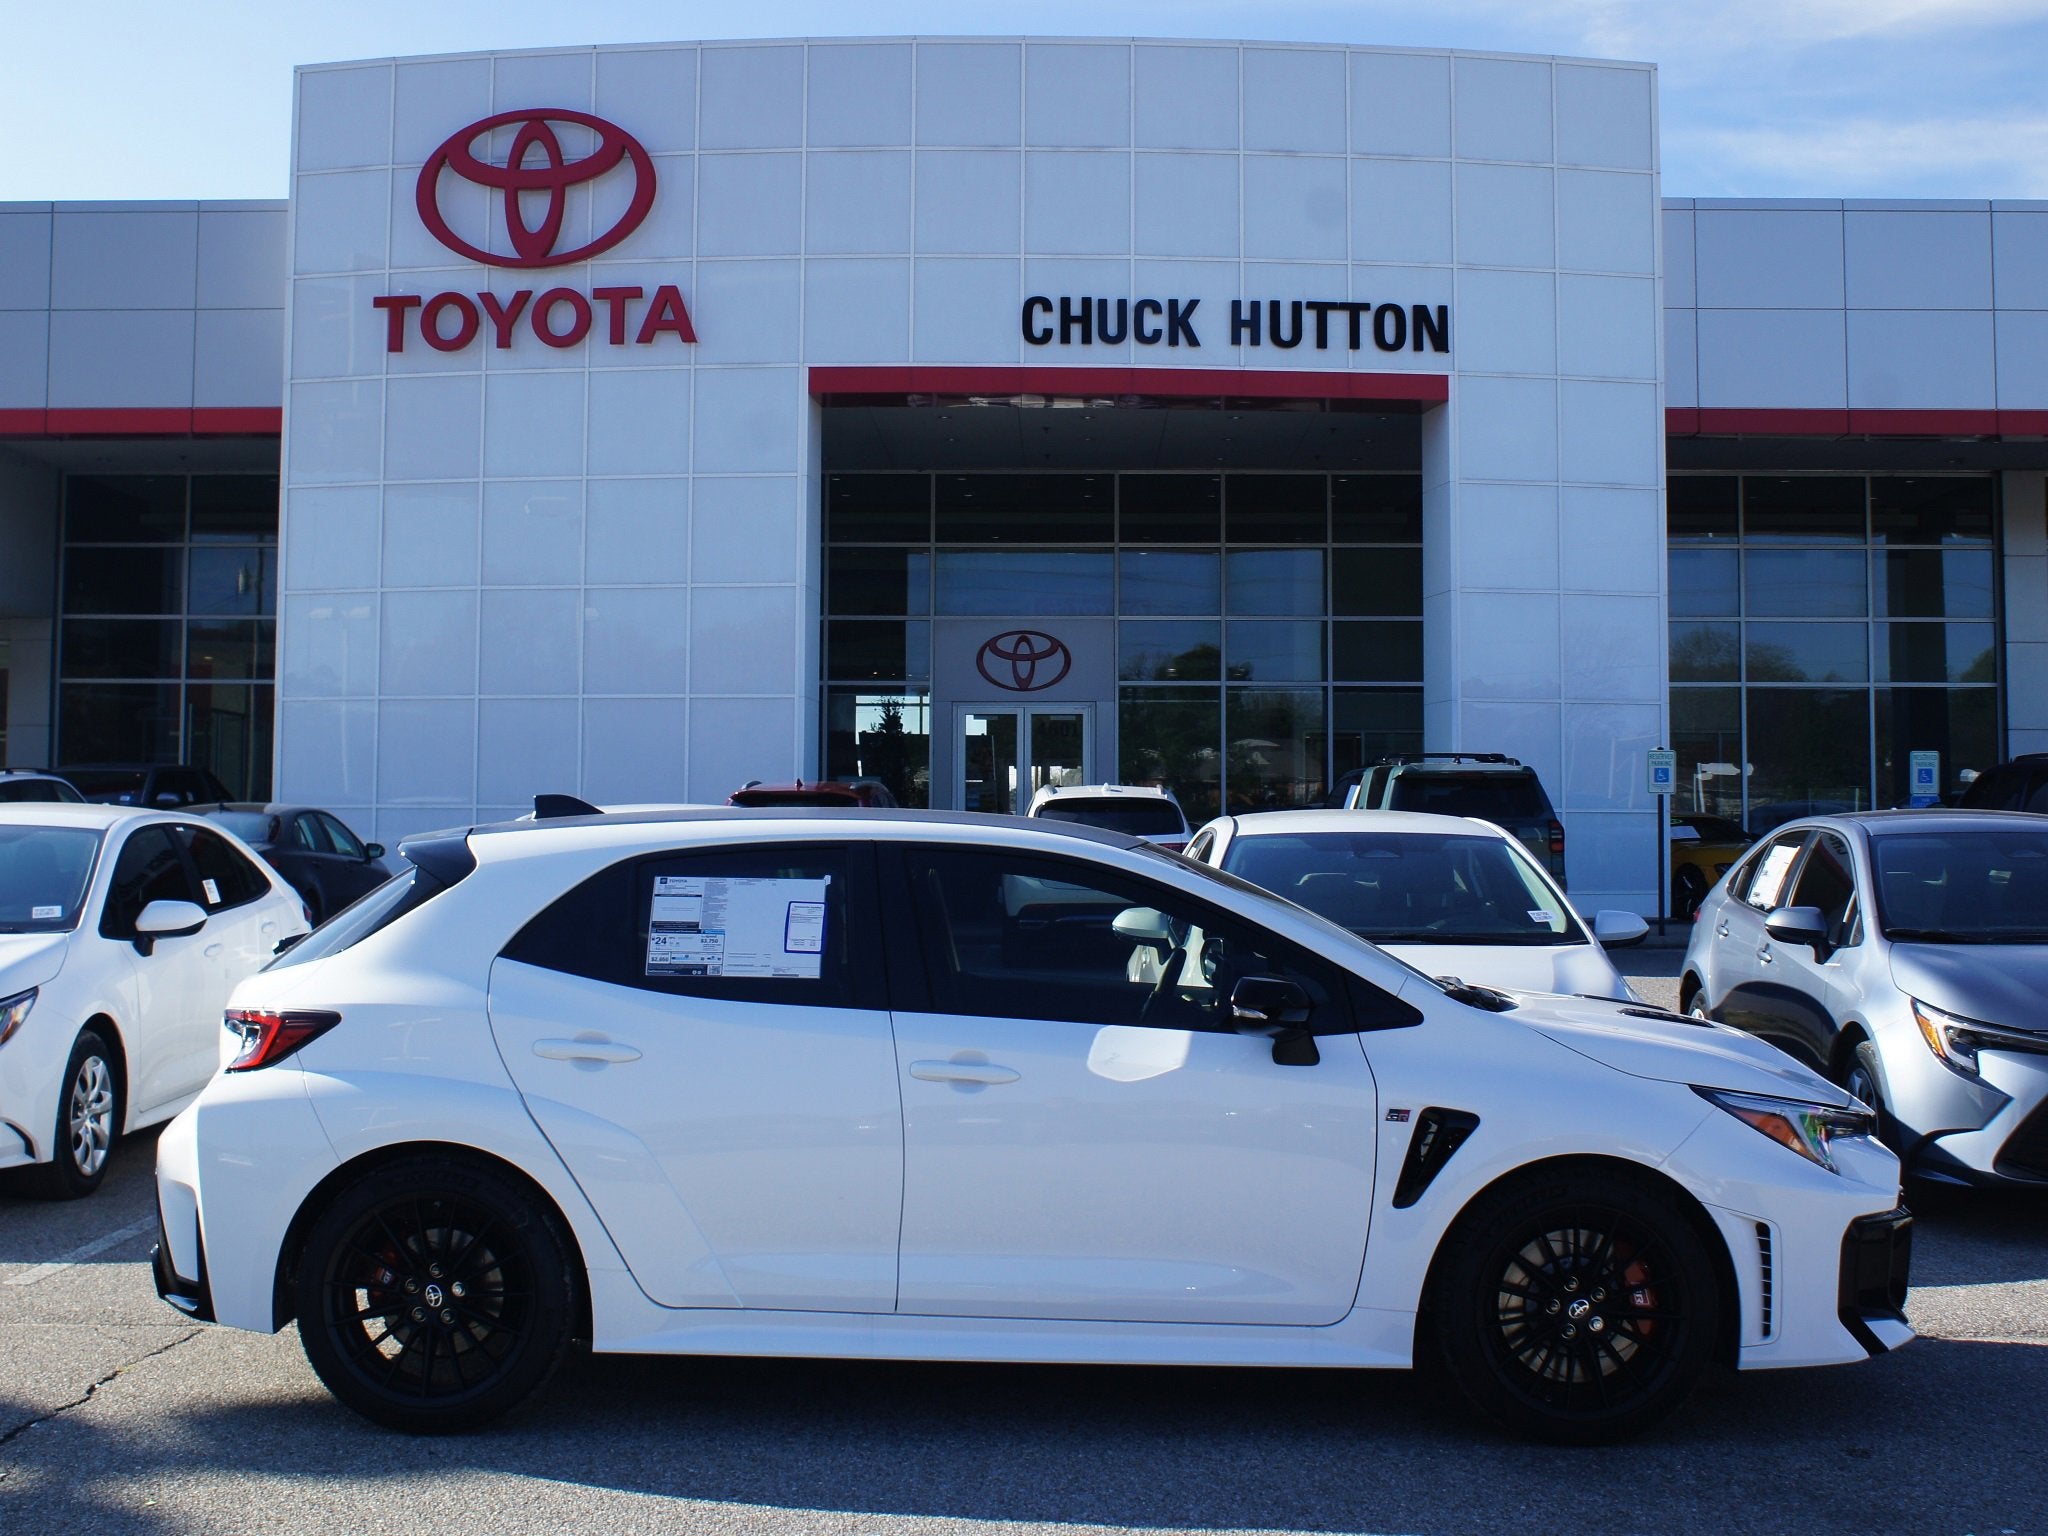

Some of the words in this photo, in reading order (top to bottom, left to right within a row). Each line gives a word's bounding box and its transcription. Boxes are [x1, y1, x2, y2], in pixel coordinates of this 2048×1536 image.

[373, 285, 698, 353] TOYOTA
[1021, 295, 1201, 347] CHUCK
[1230, 298, 1449, 353] HUTTON
[655, 936, 667, 945] 24
